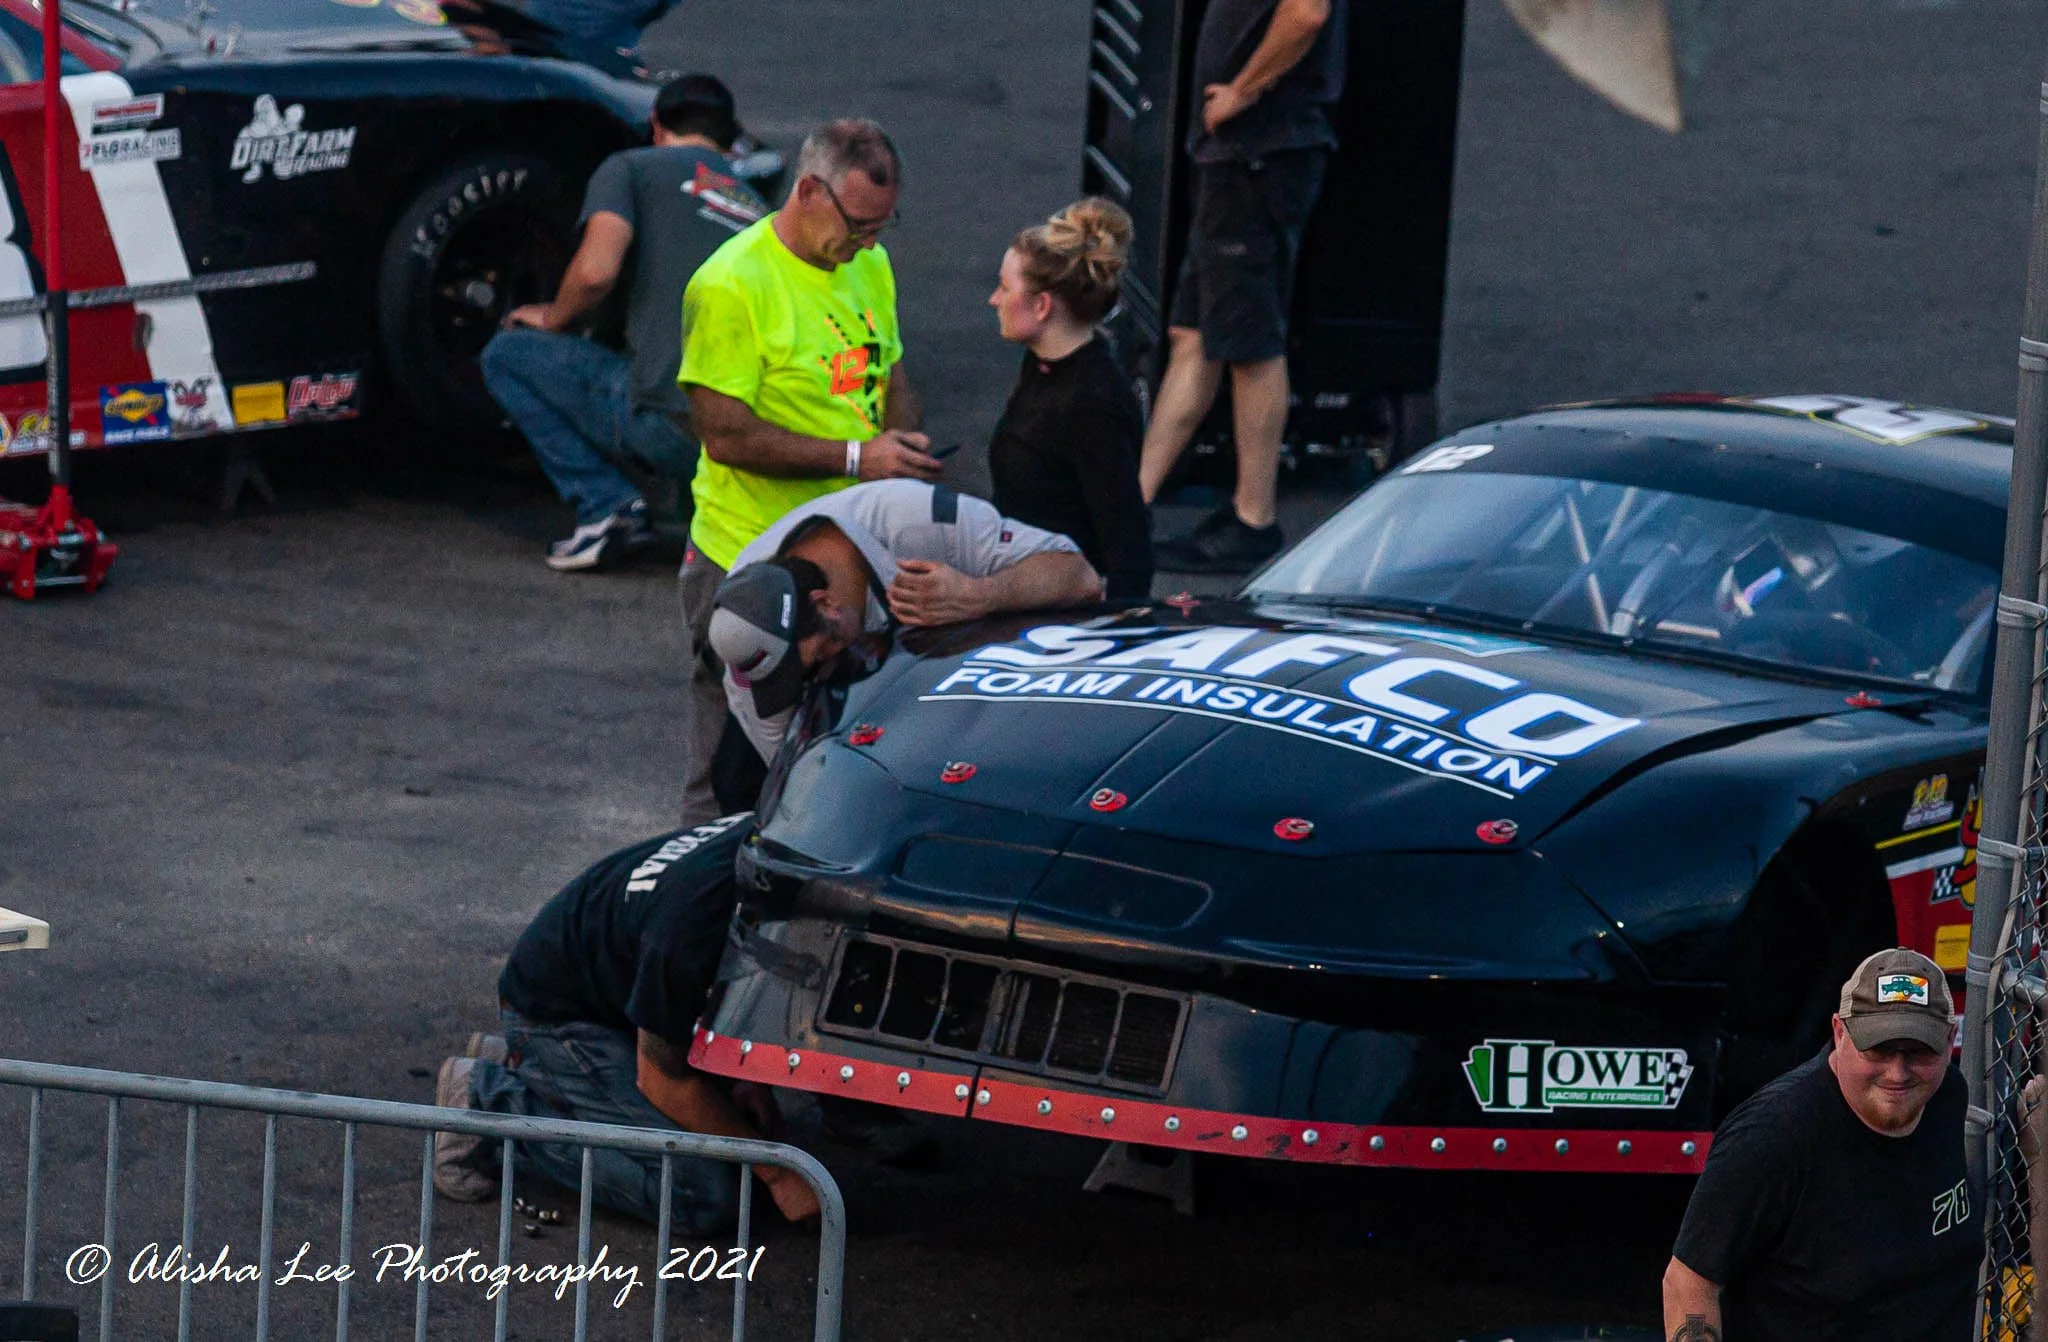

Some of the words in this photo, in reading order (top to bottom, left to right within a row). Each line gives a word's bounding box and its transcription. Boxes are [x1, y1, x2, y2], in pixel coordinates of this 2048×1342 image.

[829, 345, 869, 395] 12
[973, 624, 1642, 757] SAFCO
[935, 666, 1122, 695] FOAM
[1136, 676, 1547, 790] INSULATION
[1486, 1041, 1666, 1109] HOWE
[1548, 1091, 1588, 1102] RACING
[1590, 1091, 1661, 1102] ENTERPRISES
